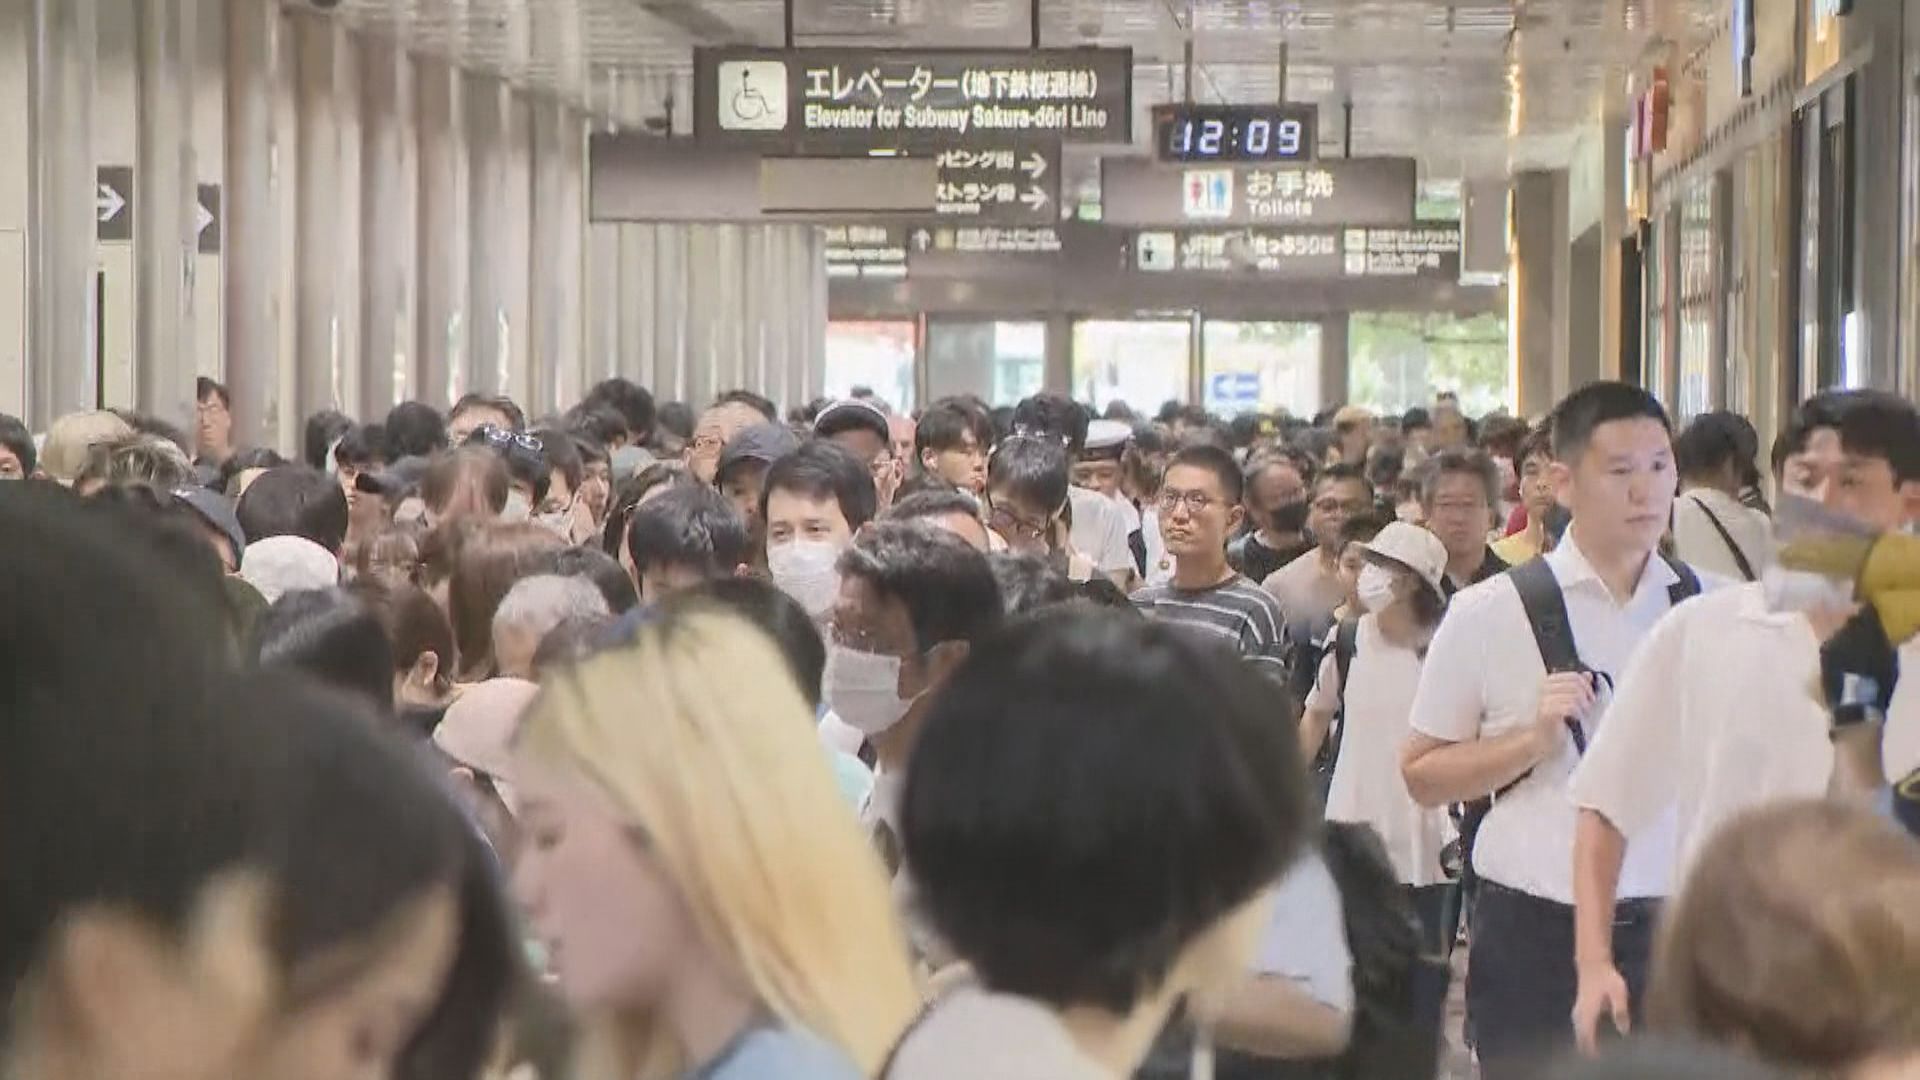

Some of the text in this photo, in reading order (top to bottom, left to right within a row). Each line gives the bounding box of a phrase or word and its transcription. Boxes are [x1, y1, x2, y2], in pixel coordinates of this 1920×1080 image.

[804, 104, 874, 128] Elevator
[877, 105, 901, 128] for
[904, 104, 970, 135] Subway
[1070, 104, 1108, 128] Line
[1183, 119, 1301, 154] 12:09
[1246, 169, 1334, 198] お手洗
